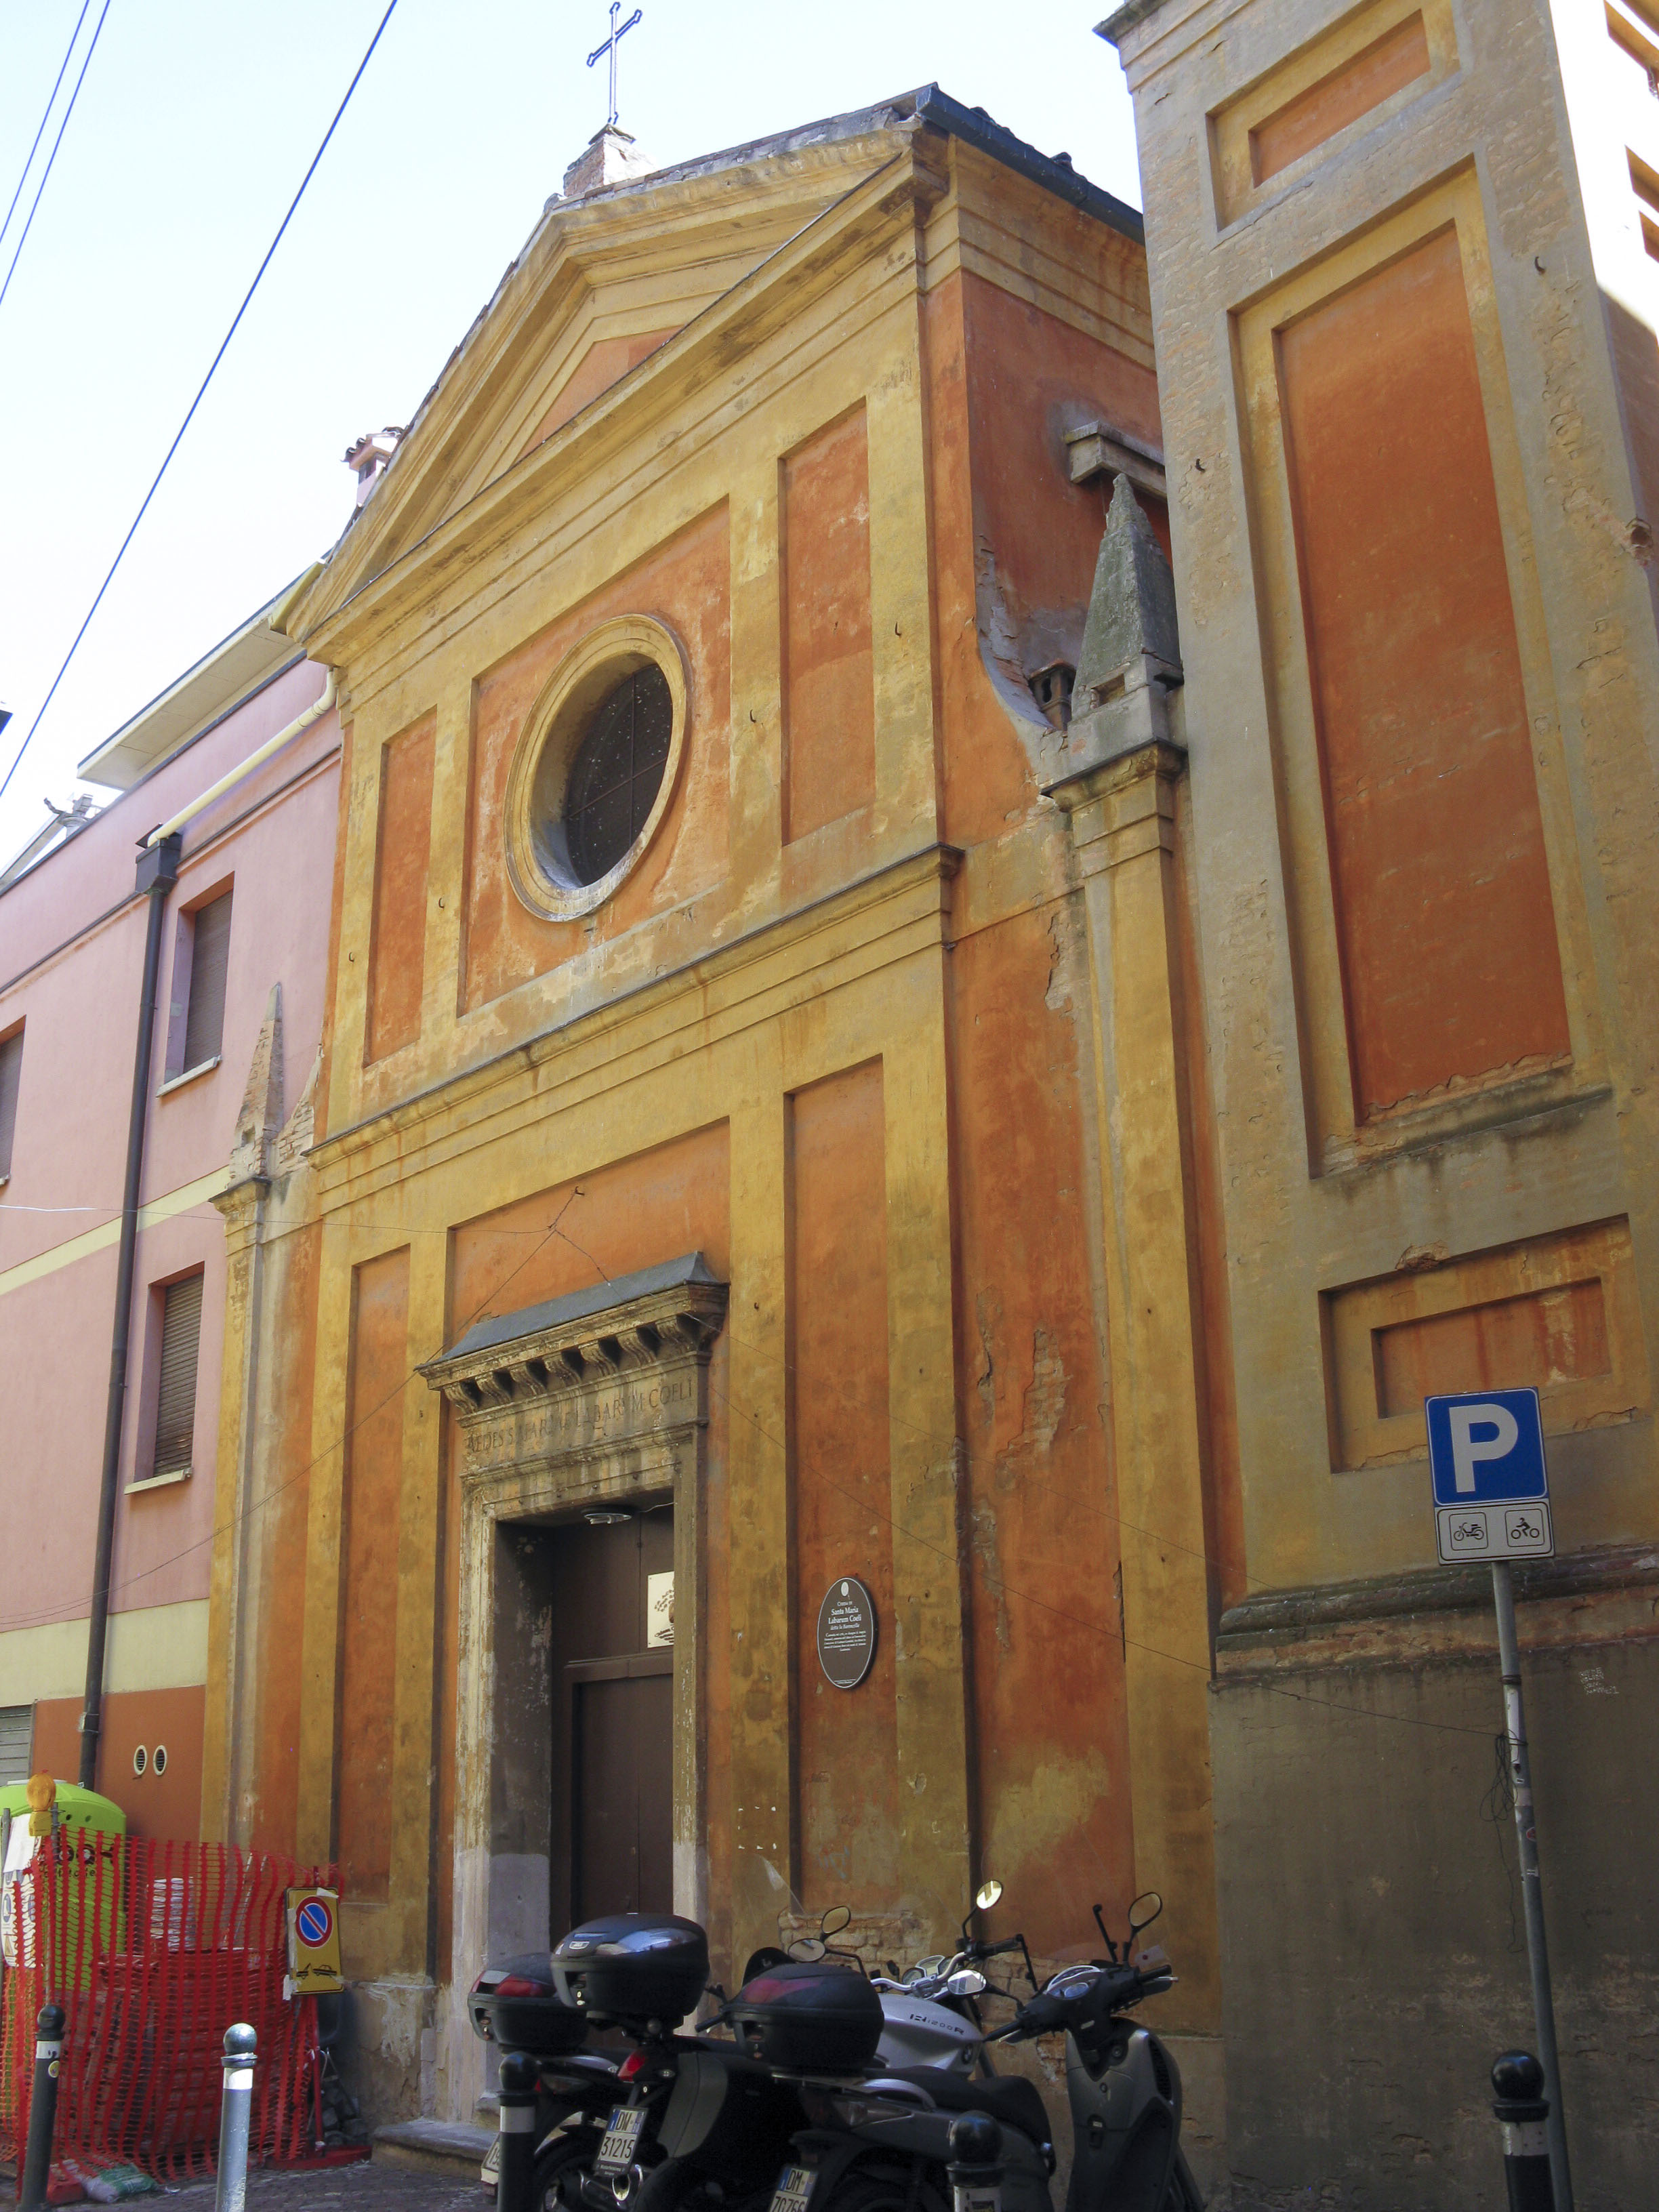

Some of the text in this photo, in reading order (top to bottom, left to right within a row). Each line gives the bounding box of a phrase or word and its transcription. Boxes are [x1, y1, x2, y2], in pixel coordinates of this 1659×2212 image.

[1449, 1404, 1519, 1493] P
[828, 1614, 861, 1624] Labarum Coeli
[844, 1606, 859, 1614] Maria
[601, 2136, 635, 2158] 31215
[785, 2169, 803, 2192] DM
